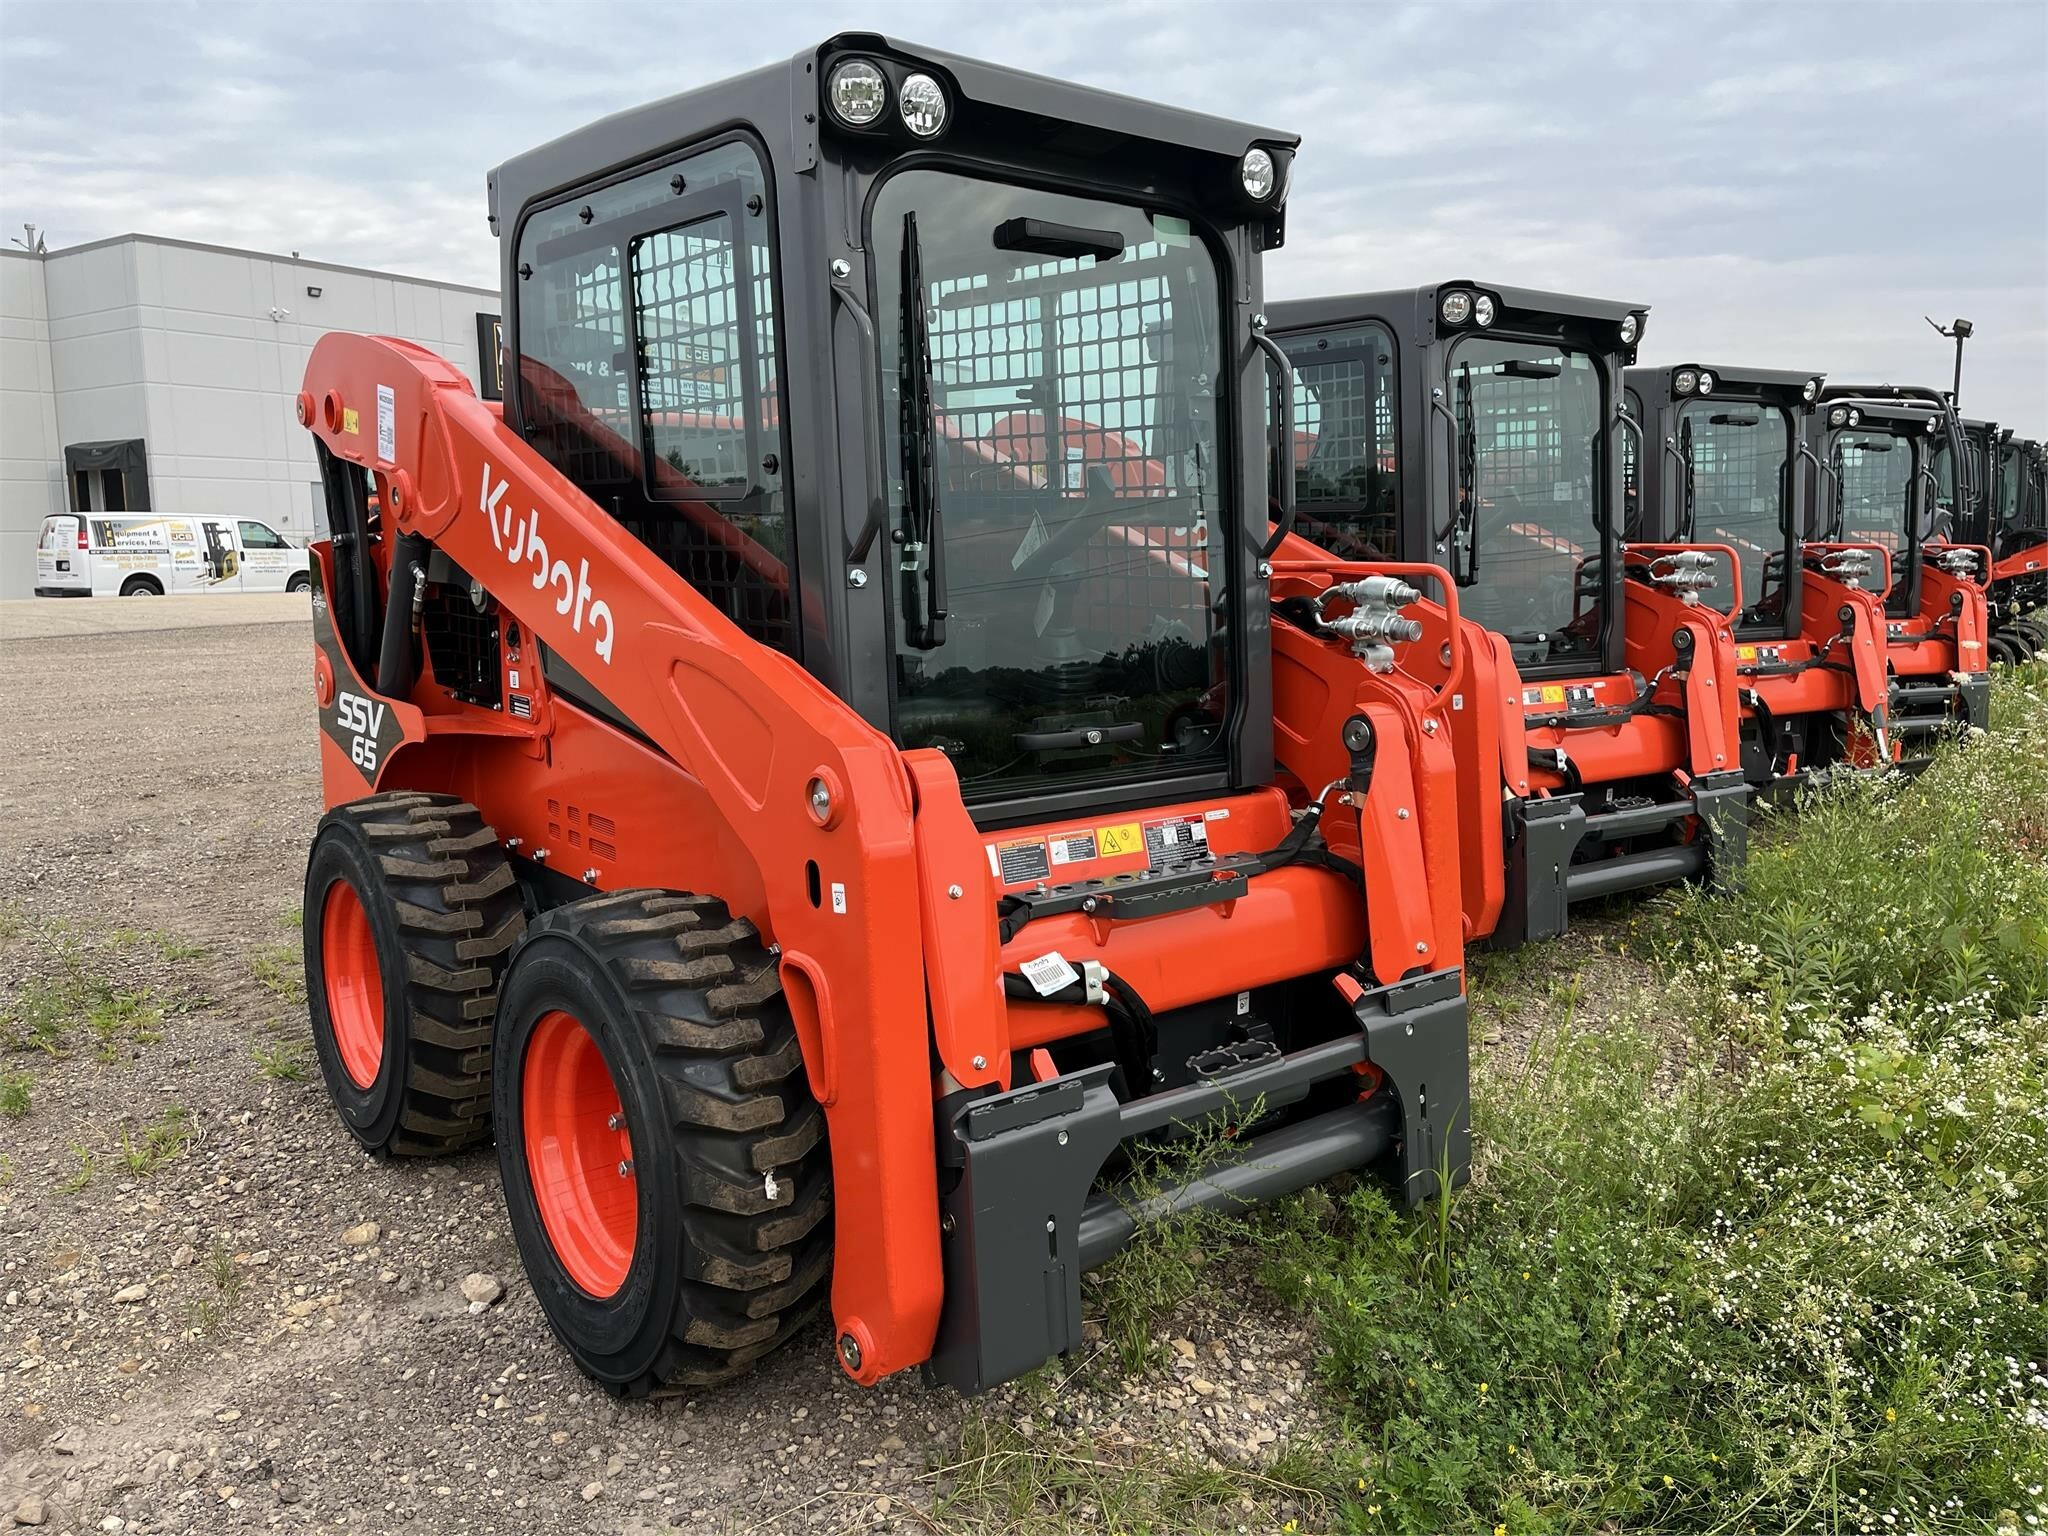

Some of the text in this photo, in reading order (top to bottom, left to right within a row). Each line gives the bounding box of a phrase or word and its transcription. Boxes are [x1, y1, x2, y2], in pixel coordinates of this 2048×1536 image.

[598, 361, 610, 377] &
[480, 462, 615, 665] Kubota
[337, 691, 385, 739] SSV
[351, 735, 377, 771] 65
